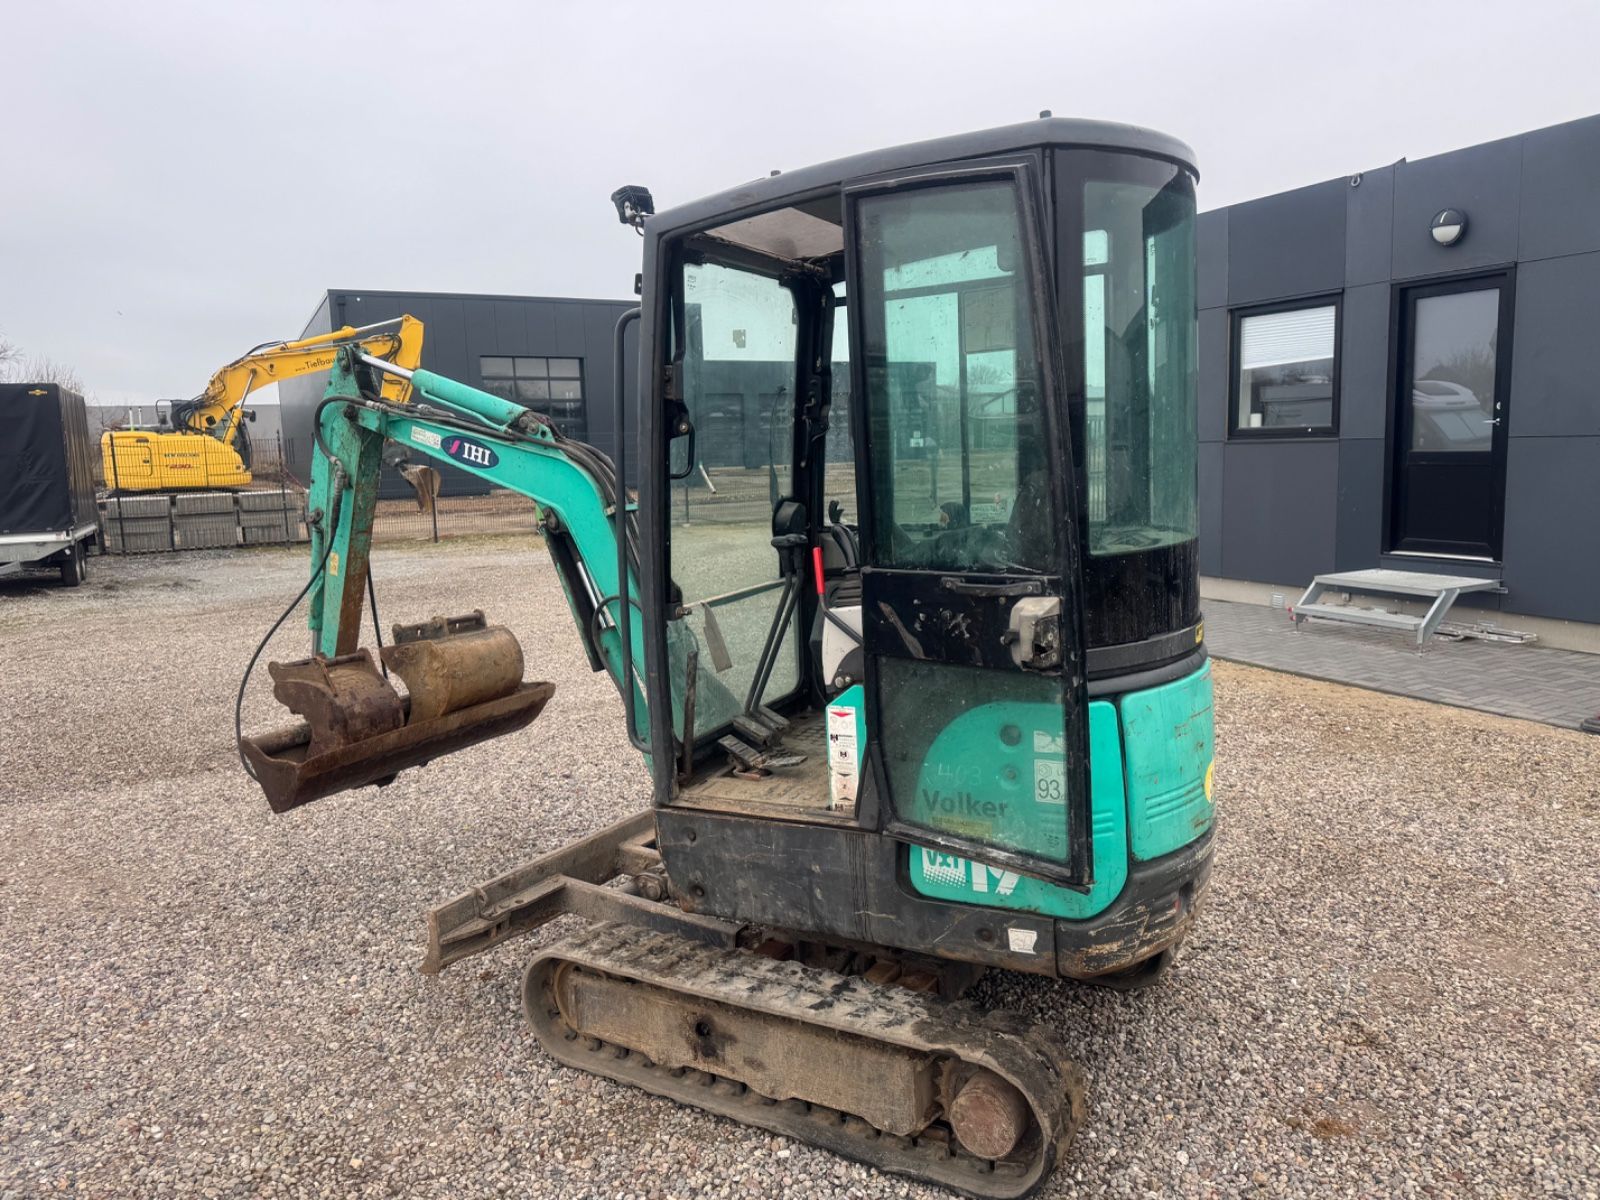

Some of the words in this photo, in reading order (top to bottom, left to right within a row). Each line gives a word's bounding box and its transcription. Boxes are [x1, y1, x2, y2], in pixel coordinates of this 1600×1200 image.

[462, 442, 491, 466] IHI
[1038, 778, 1061, 800] 93
[922, 788, 1008, 818] Volker
